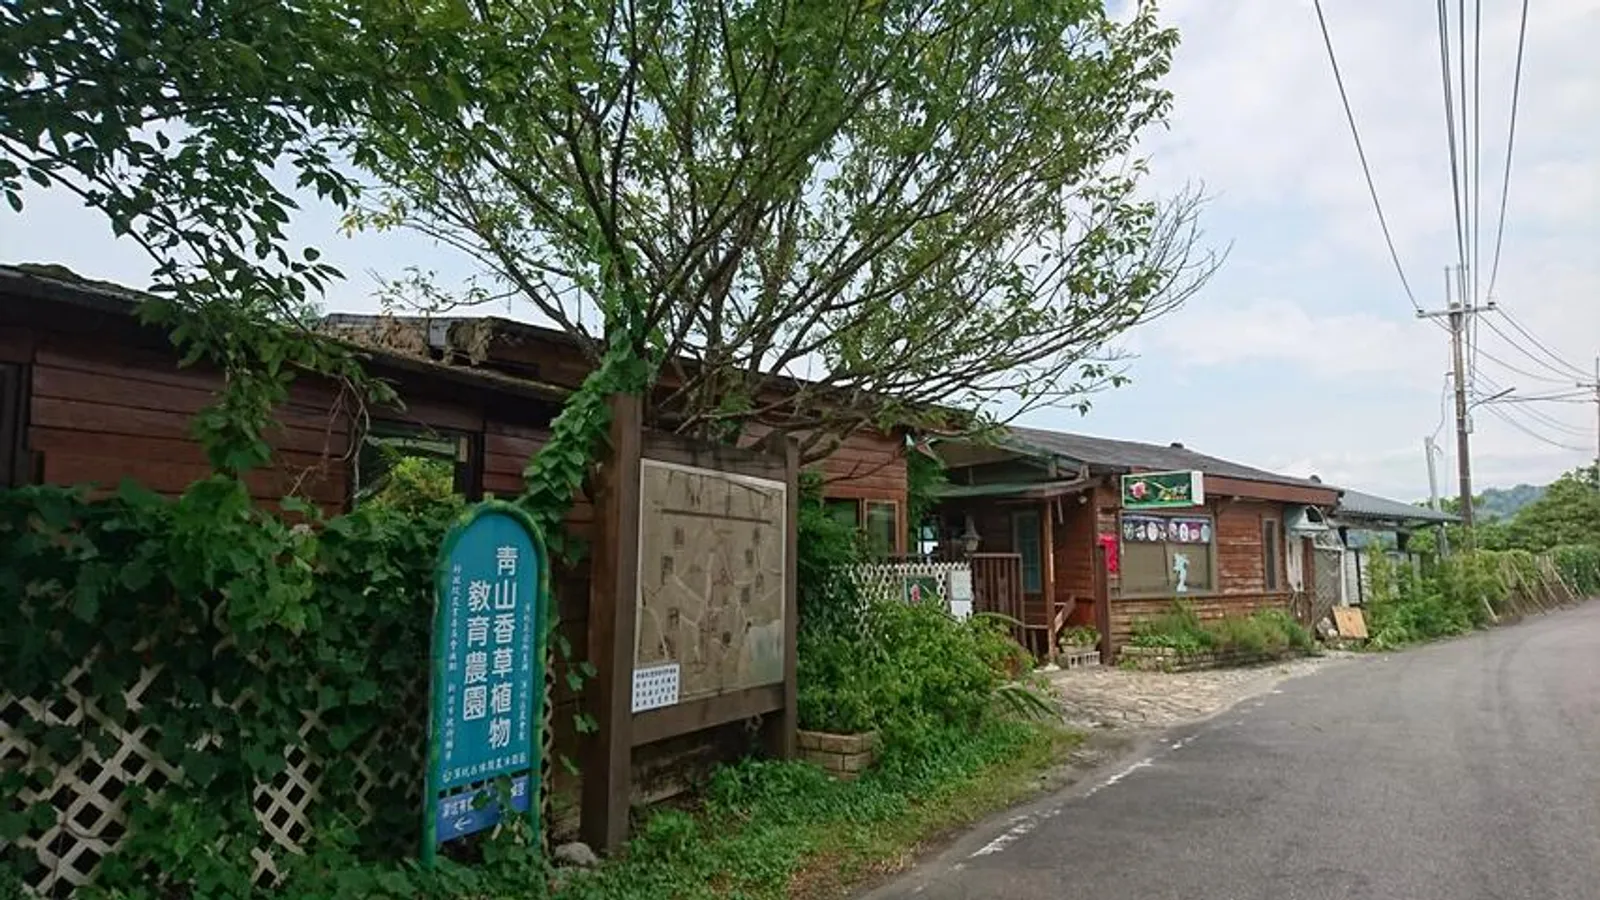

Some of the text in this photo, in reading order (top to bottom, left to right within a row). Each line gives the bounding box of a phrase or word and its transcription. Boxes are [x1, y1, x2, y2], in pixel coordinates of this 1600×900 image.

[463, 580, 491, 721] 教育農園
[489, 545, 518, 749] 青山香草植物
